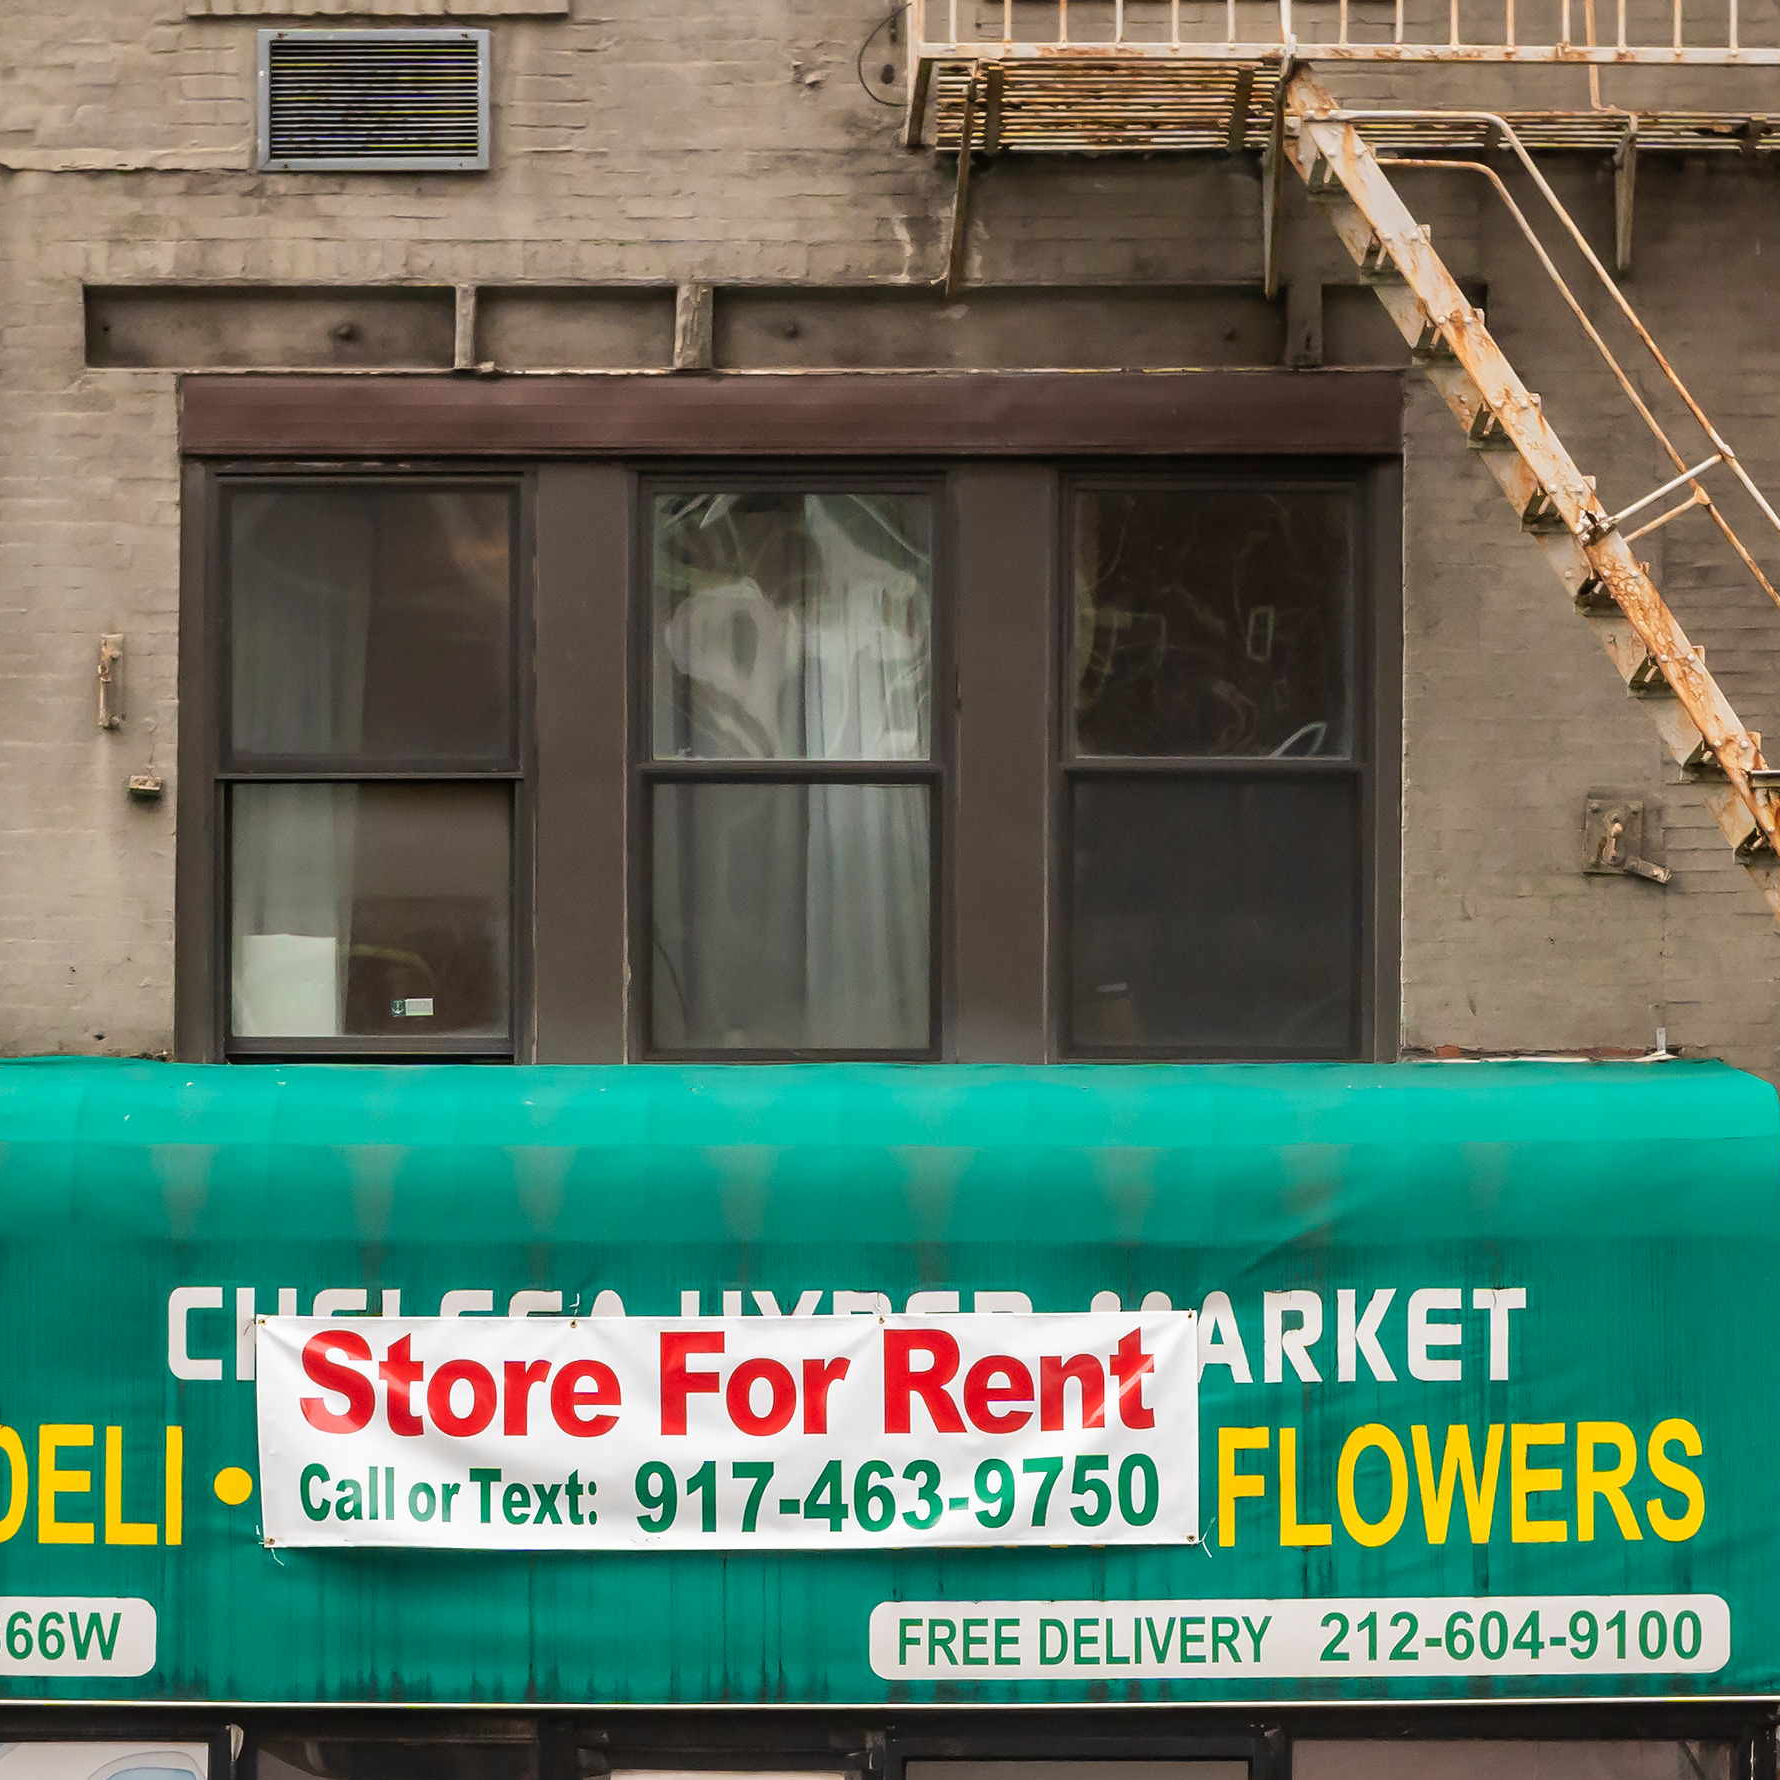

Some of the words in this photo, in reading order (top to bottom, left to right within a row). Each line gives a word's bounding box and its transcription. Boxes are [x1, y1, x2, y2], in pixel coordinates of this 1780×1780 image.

[300, 1330, 621, 1438] Store
[658, 1331, 851, 1437] For
[883, 1327, 1155, 1435] Rent
[1090, 1287, 1526, 1384] ARKET
[300, 1463, 396, 1524] Call
[410, 1479, 462, 1524] or
[470, 1468, 599, 1526] Text:
[635, 1453, 1159, 1534] 917-463-9750
[1219, 1418, 1706, 1547] FLOWERS
[898, 1617, 1022, 1667] FREE
[1039, 1615, 1272, 1665] DELIVERY
[1320, 1609, 1703, 1663] 212-604-9100
